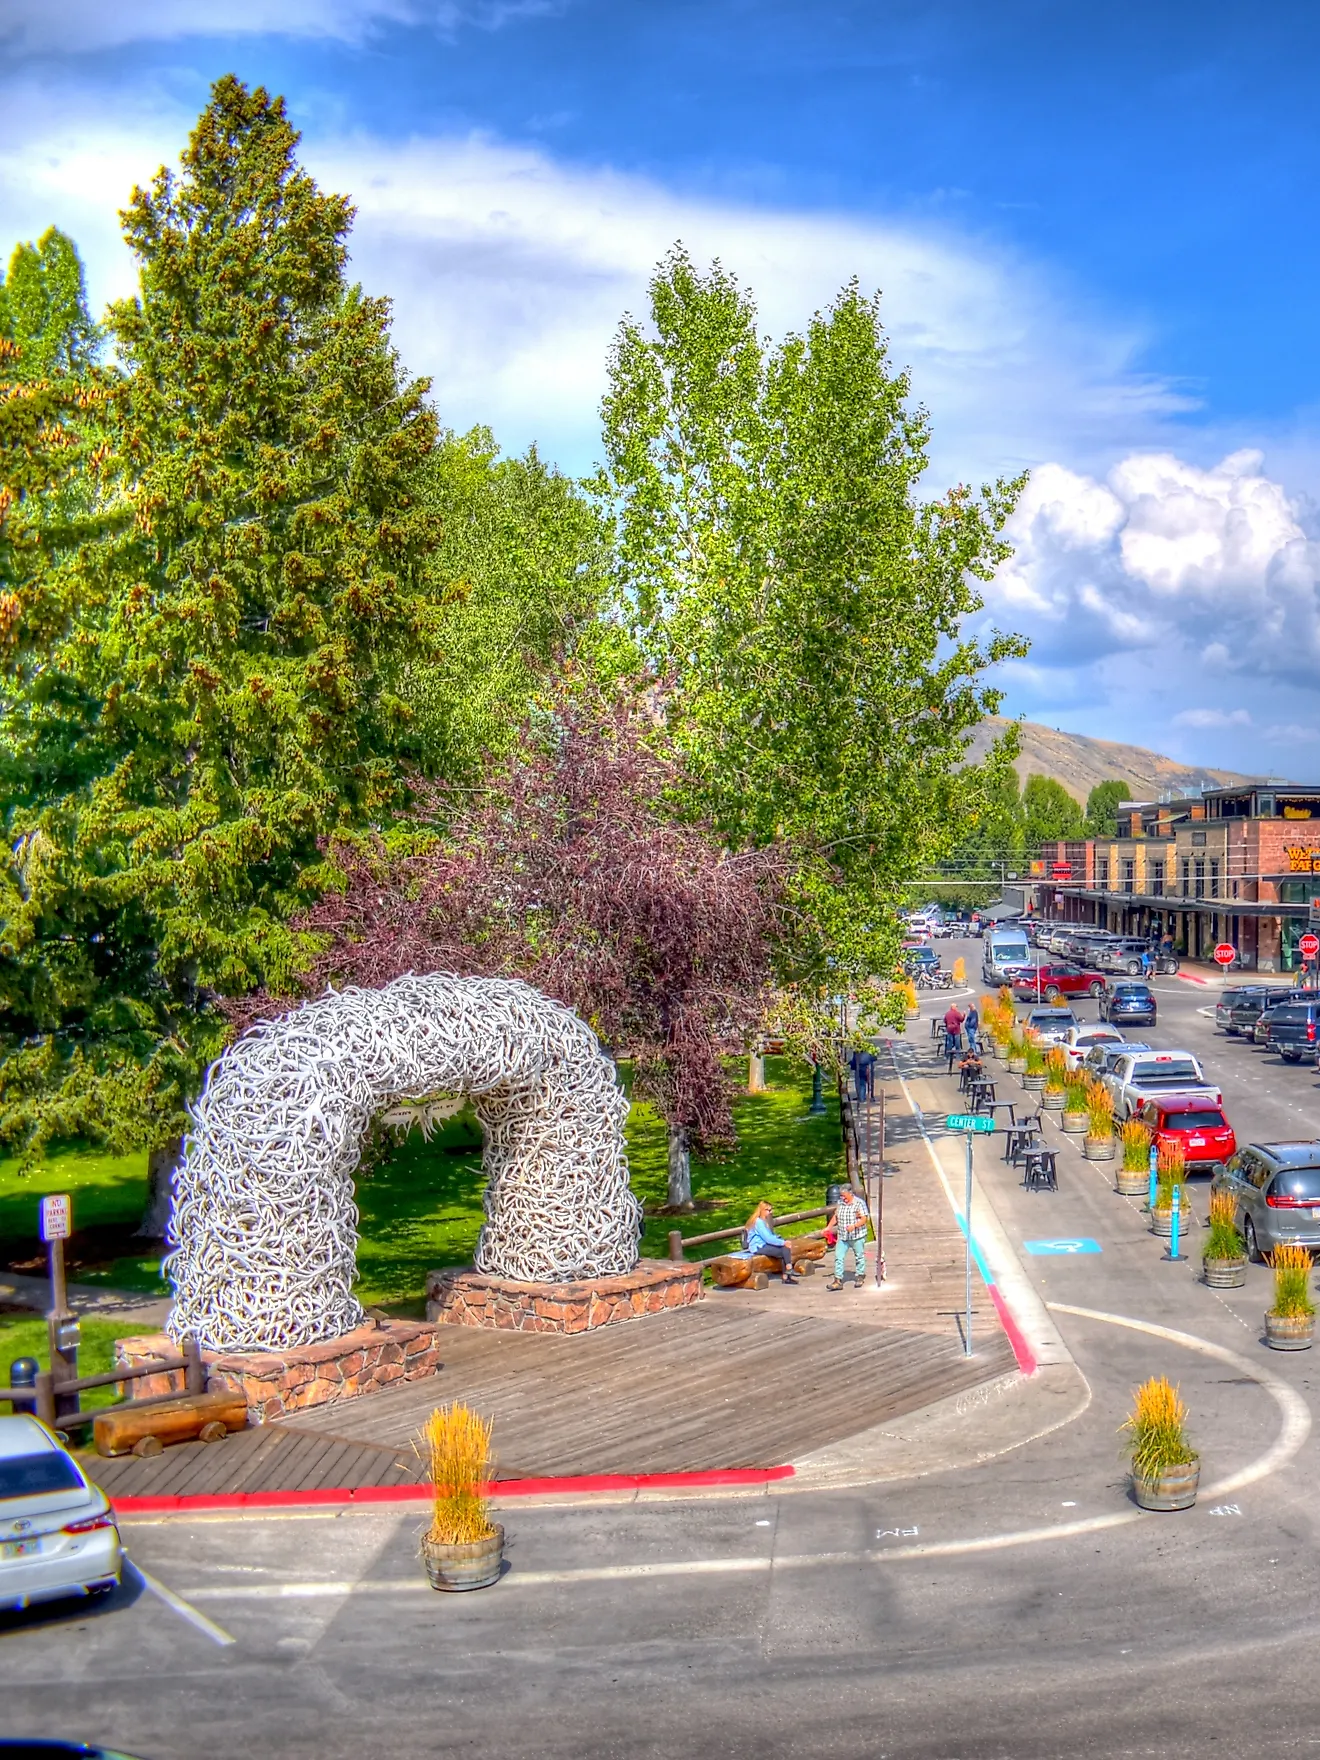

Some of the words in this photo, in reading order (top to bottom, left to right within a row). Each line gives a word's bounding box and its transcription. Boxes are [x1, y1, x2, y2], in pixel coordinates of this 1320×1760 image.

[1301, 941, 1318, 949] STOP
[1215, 950, 1234, 958] STOP
[950, 1116, 976, 1129] CENTER
[982, 1119, 992, 1130] ST
